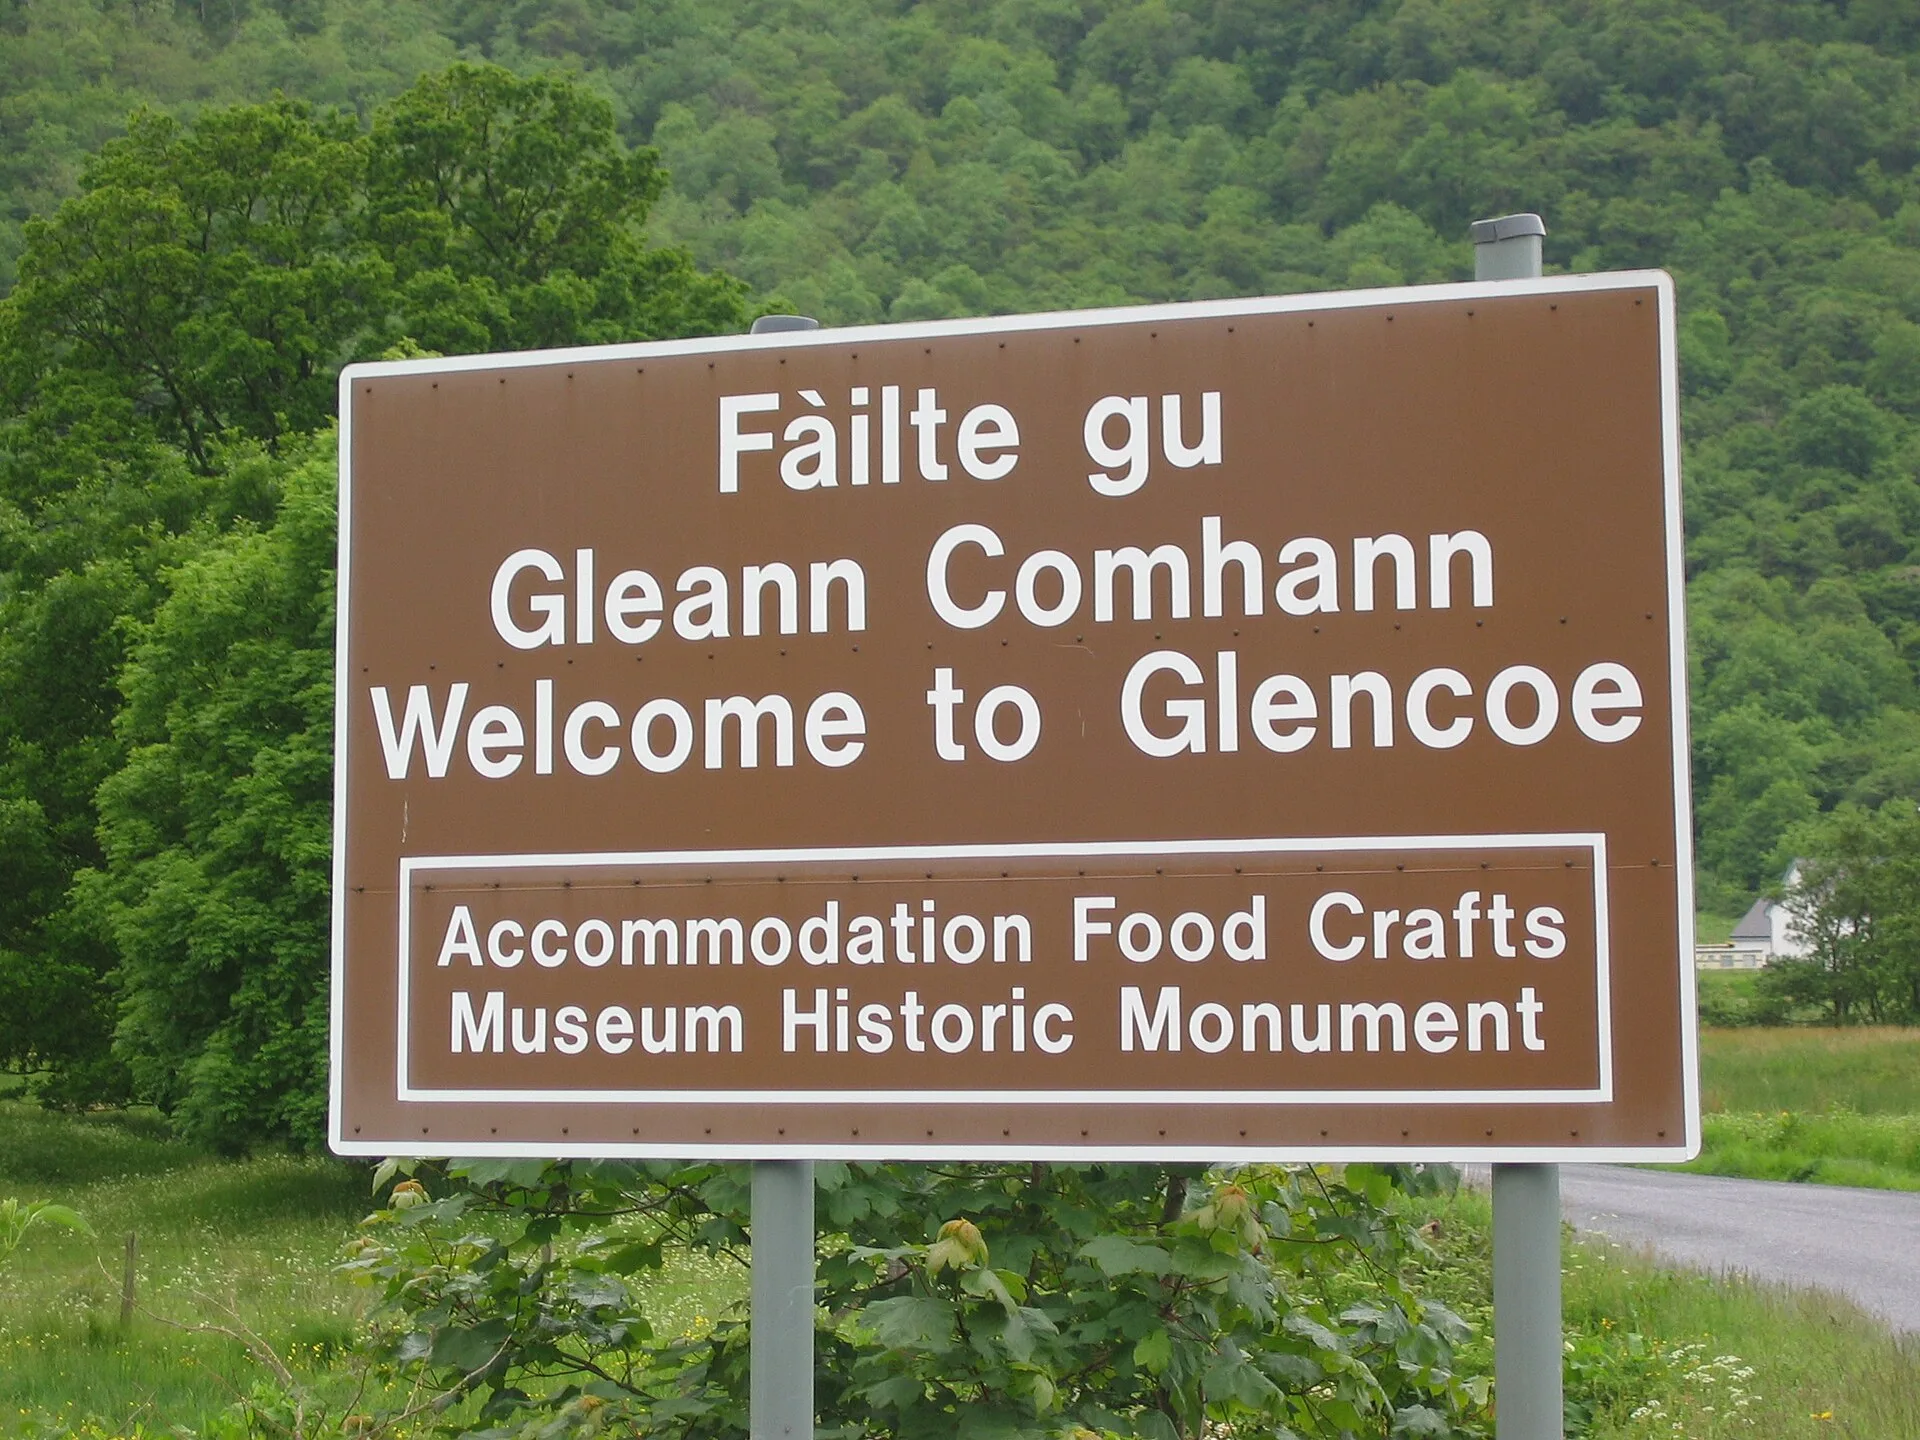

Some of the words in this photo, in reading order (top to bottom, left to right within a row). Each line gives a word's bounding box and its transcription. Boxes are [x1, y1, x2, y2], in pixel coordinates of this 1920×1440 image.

[718, 386, 1021, 495] Fàilte
[1083, 391, 1223, 497] gu
[489, 548, 868, 649] Gleann
[926, 515, 1495, 629] Comhann
[369, 678, 868, 780] Welcome
[926, 667, 1041, 762] to
[1120, 650, 1643, 758] Glencoe
[437, 900, 1032, 968] Accommodation
[1074, 894, 1266, 963] Food
[1309, 890, 1567, 962] Crafts
[451, 991, 743, 1055] Museum
[783, 987, 1074, 1054] Historic
[1120, 986, 1546, 1054] Monument
